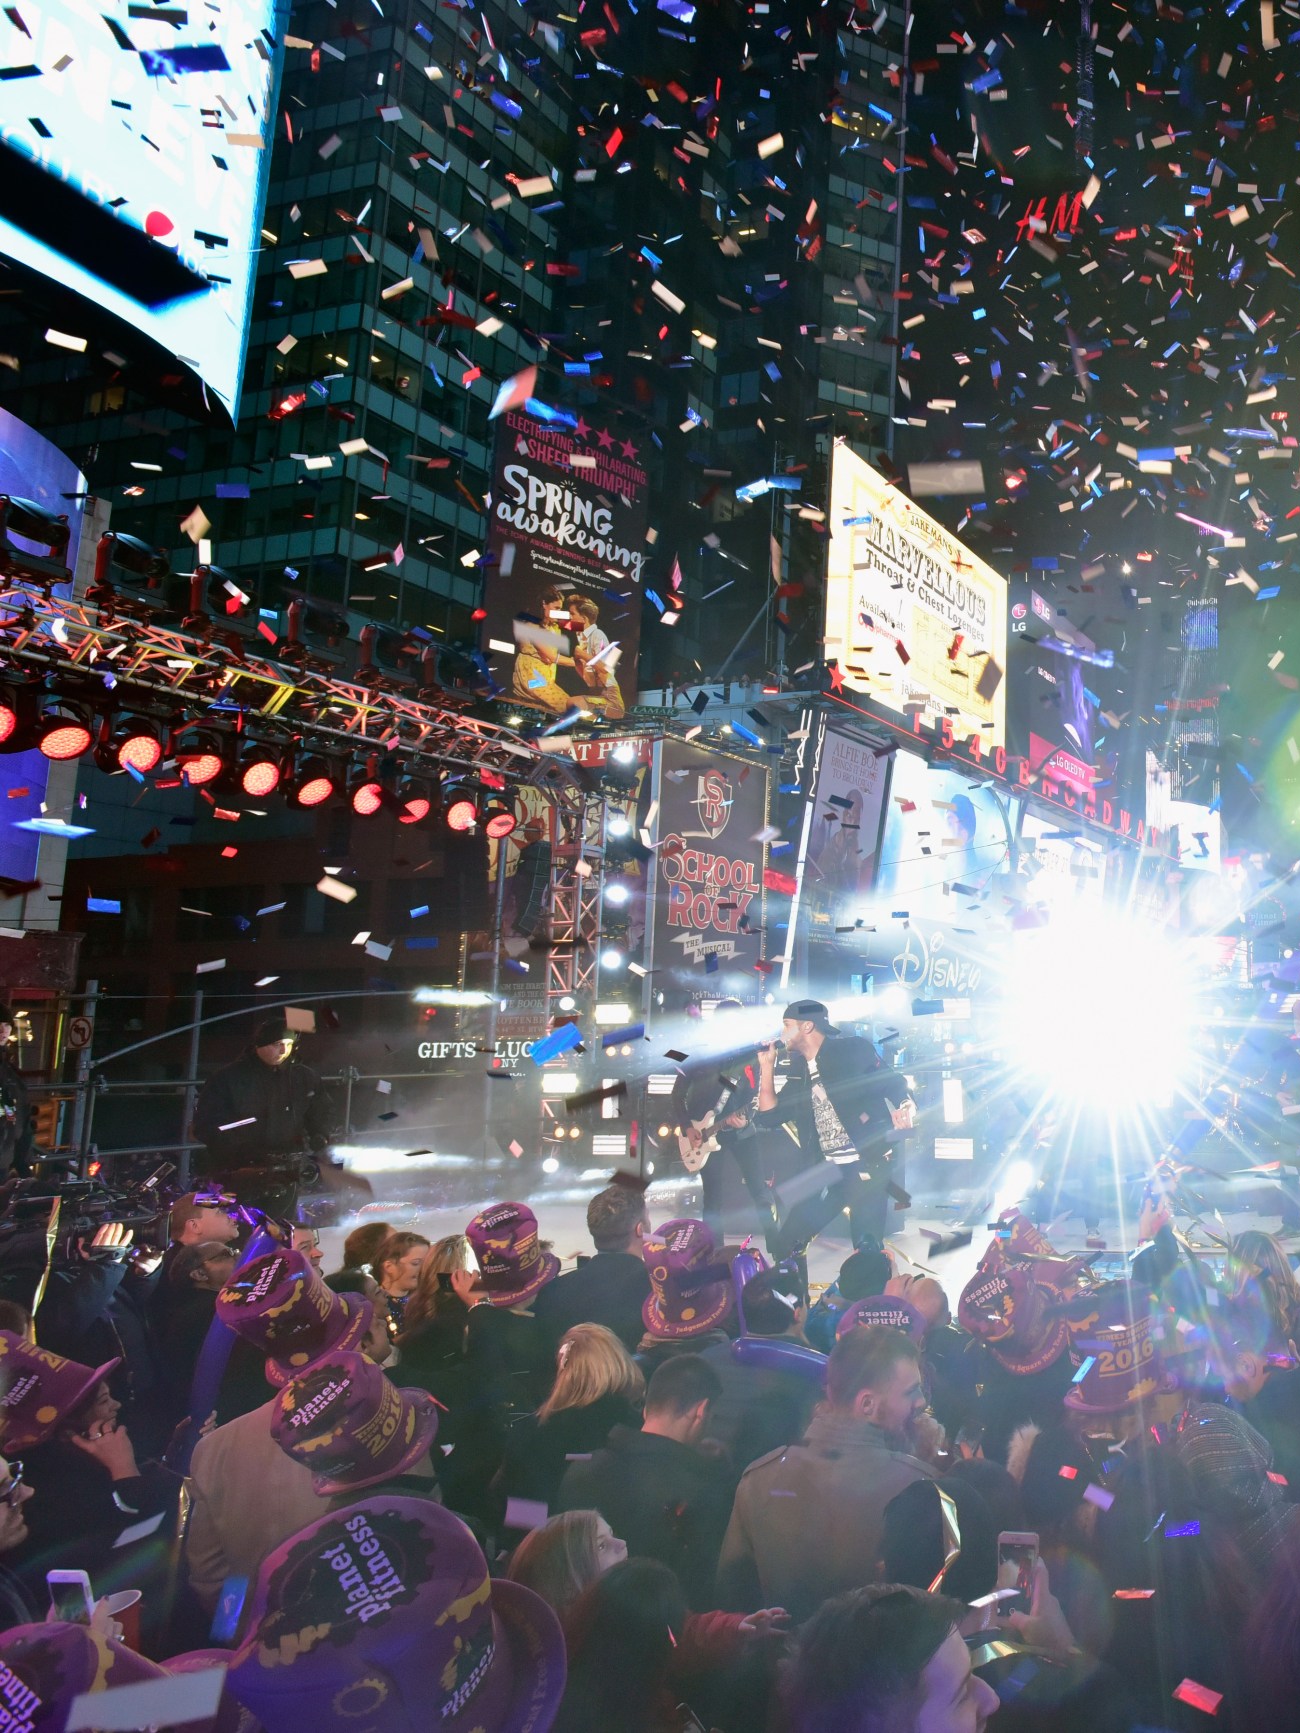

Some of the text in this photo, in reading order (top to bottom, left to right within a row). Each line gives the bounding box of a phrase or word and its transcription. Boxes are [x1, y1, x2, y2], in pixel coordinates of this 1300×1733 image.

[504, 464, 613, 535] SPRING
[497, 502, 645, 582] awakening
[866, 510, 986, 627] MARVELLOUS
[907, 578, 915, 592] &
[918, 586, 944, 616] Chest
[1012, 622, 1026, 632] LG
[1056, 755, 1064, 768] LG
[667, 880, 753, 935] ROCK
[705, 884, 720, 898] OF
[686, 939, 699, 949] THE
[418, 1041, 476, 1058] GIFTS
[965, 1277, 1001, 1304] fitness
[975, 1279, 1009, 1308] planet
[858, 1310, 904, 1319] fitness
[867, 1315, 910, 1327] planet
[1098, 1337, 1154, 1373] 2016
[289, 1380, 338, 1428] planet
[301, 1377, 350, 1426] fitness
[344, 1514, 407, 1602] fitness
[319, 1542, 391, 1624] planet
[441, 1644, 493, 1719] planet
